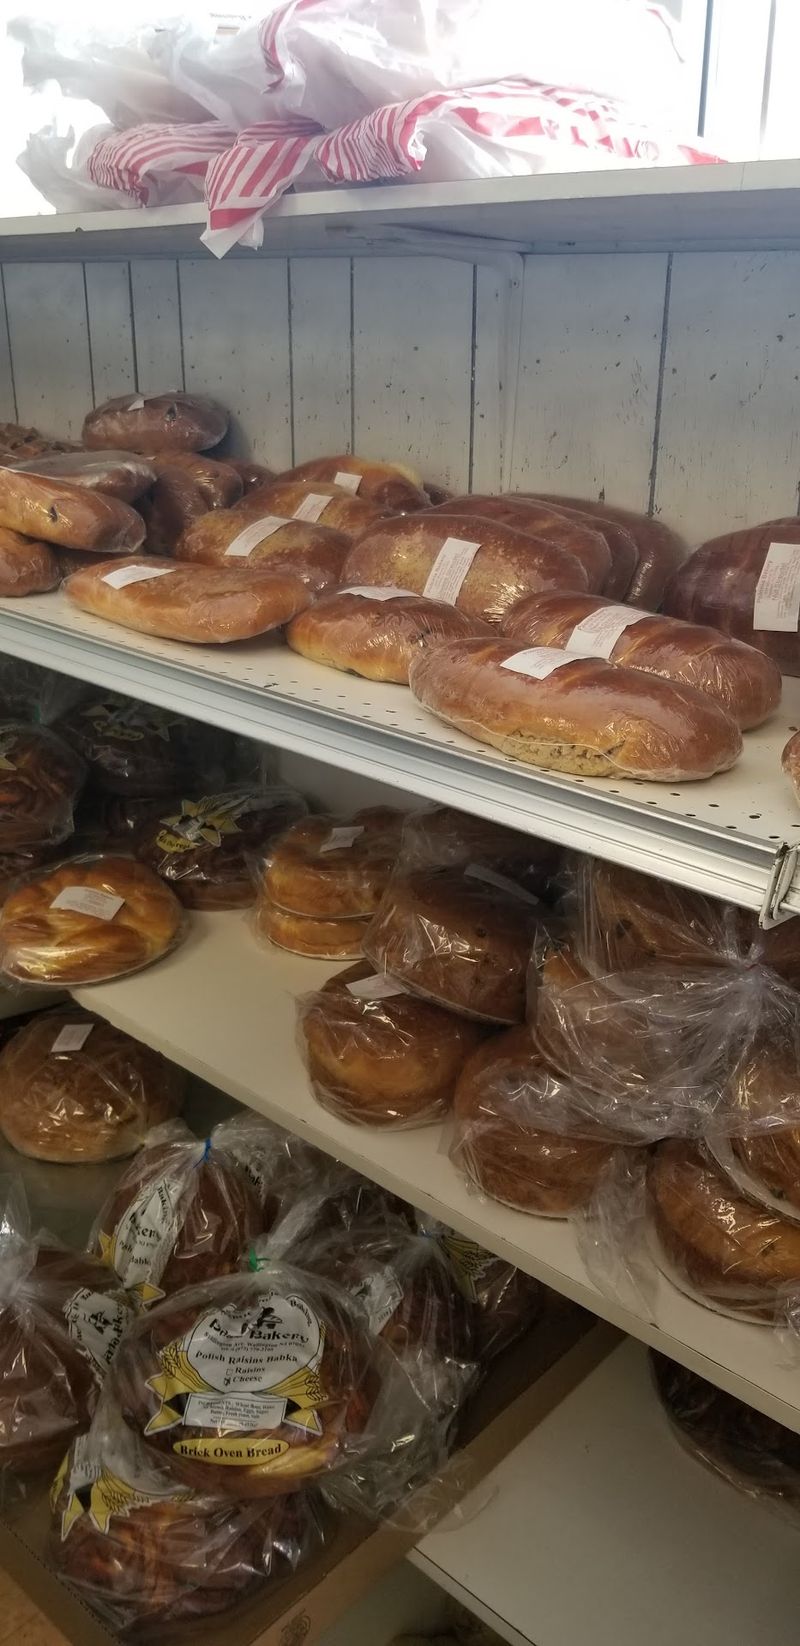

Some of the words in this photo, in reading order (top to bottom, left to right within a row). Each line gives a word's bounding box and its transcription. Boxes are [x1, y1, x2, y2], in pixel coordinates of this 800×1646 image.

[249, 1330, 309, 1343] Bakery
[195, 1351, 226, 1362] Polish
[228, 1356, 264, 1366] Raisins
[266, 1354, 298, 1363] Babka
[235, 1366, 265, 1374] Raisins
[180, 1444, 210, 1458] Brick
[213, 1447, 243, 1458] Oven
[247, 1443, 282, 1458] Bread
